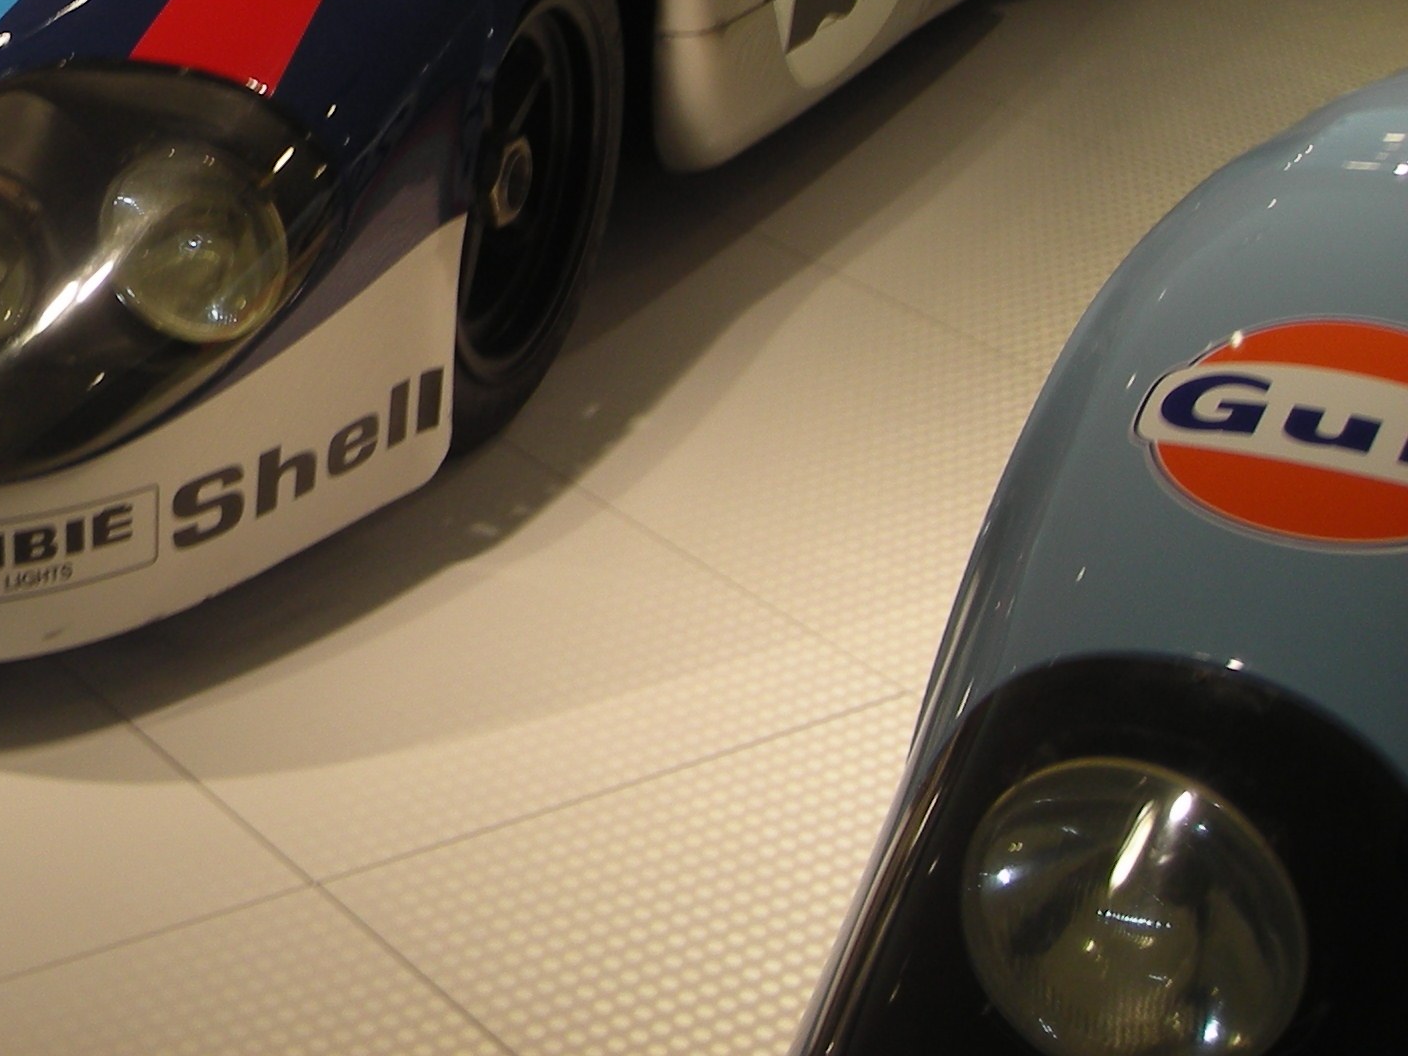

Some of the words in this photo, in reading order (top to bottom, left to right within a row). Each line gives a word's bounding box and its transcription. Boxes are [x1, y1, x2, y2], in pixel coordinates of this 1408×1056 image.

[171, 367, 445, 551] Shell
[1160, 374, 1408, 463] Gu
[3, 561, 74, 591] LIGHTS
